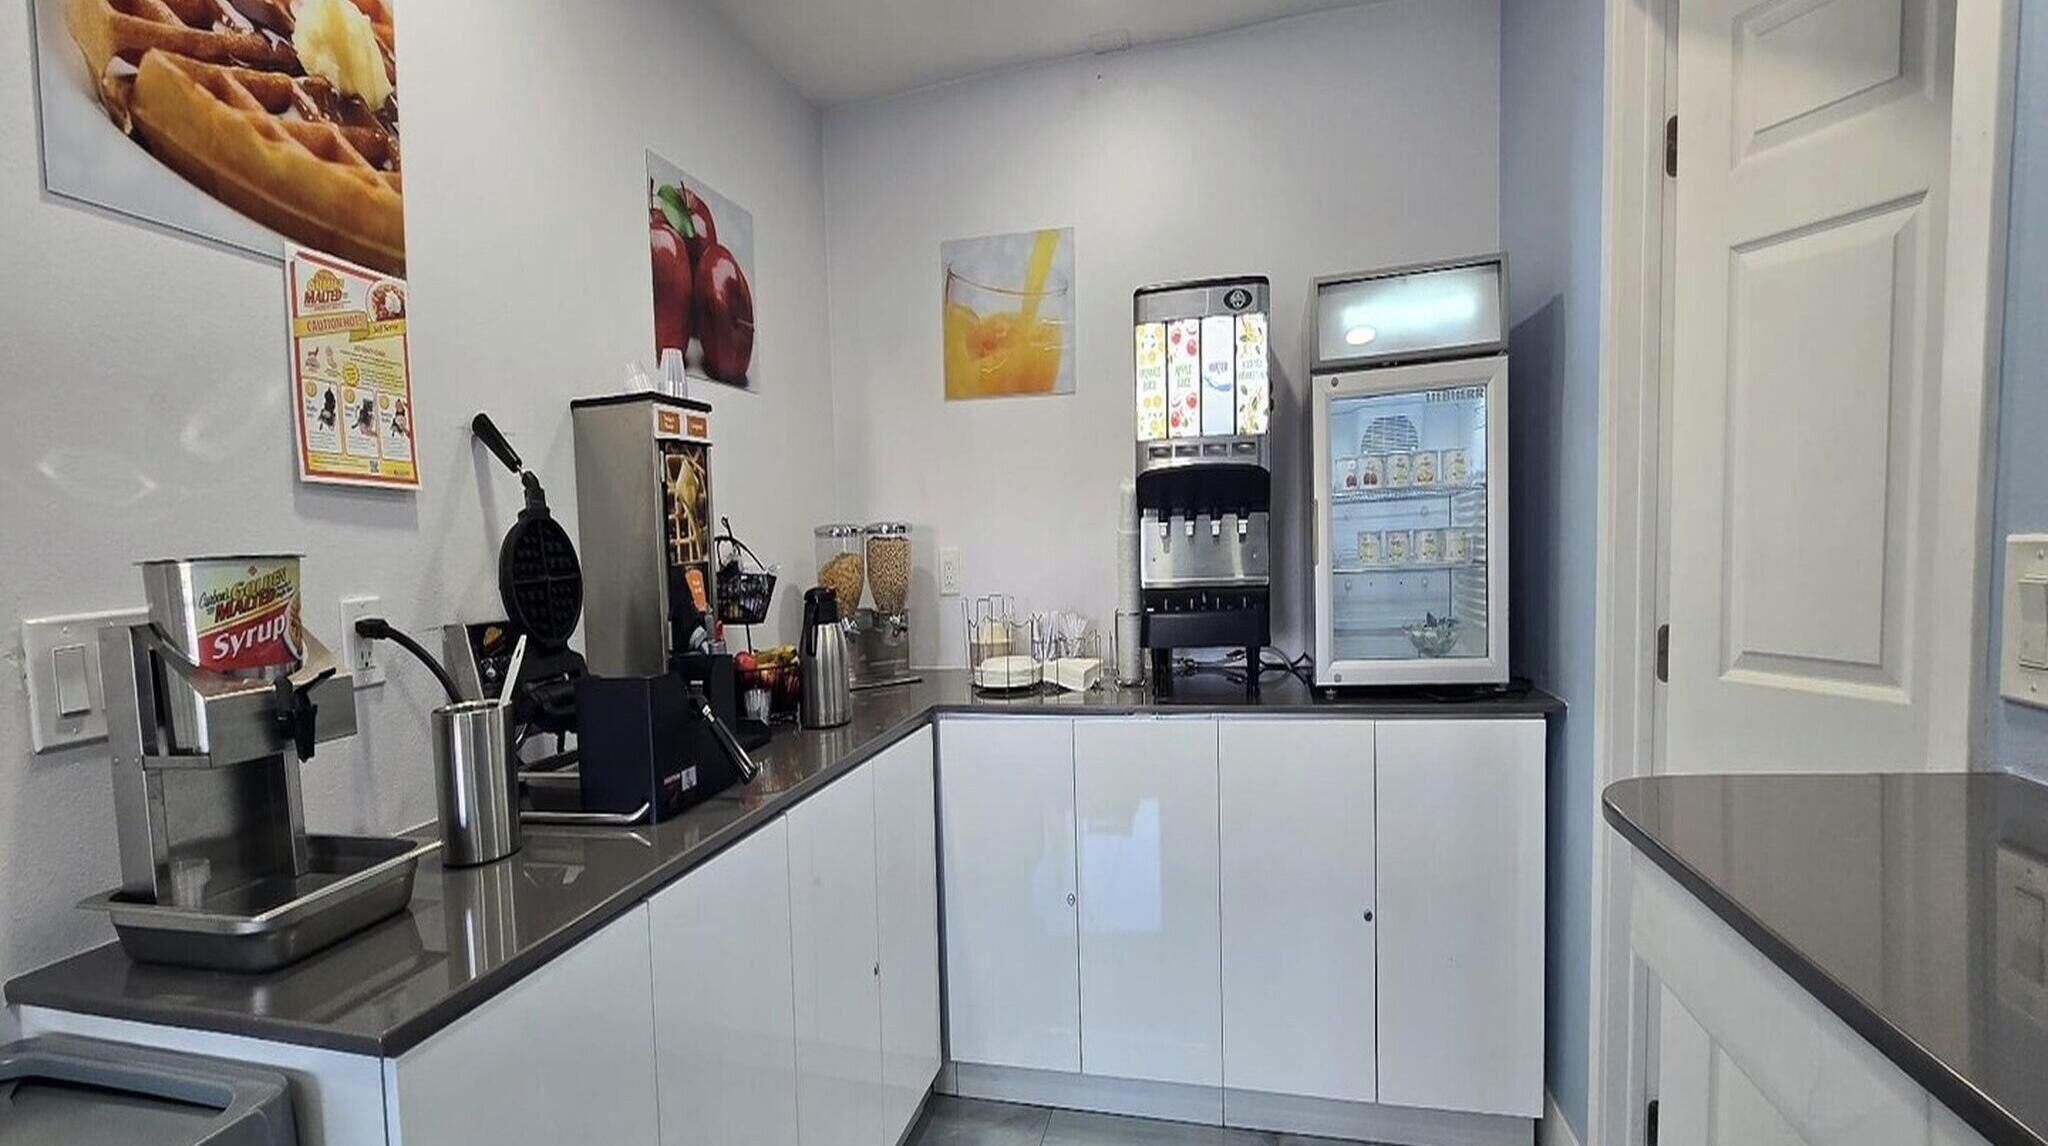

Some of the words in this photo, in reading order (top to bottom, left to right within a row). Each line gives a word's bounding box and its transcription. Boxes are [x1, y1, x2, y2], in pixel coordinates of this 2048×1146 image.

[306, 316, 343, 333] CAUTION
[214, 587, 278, 623] MALTED
[212, 613, 287, 660] Syrup
